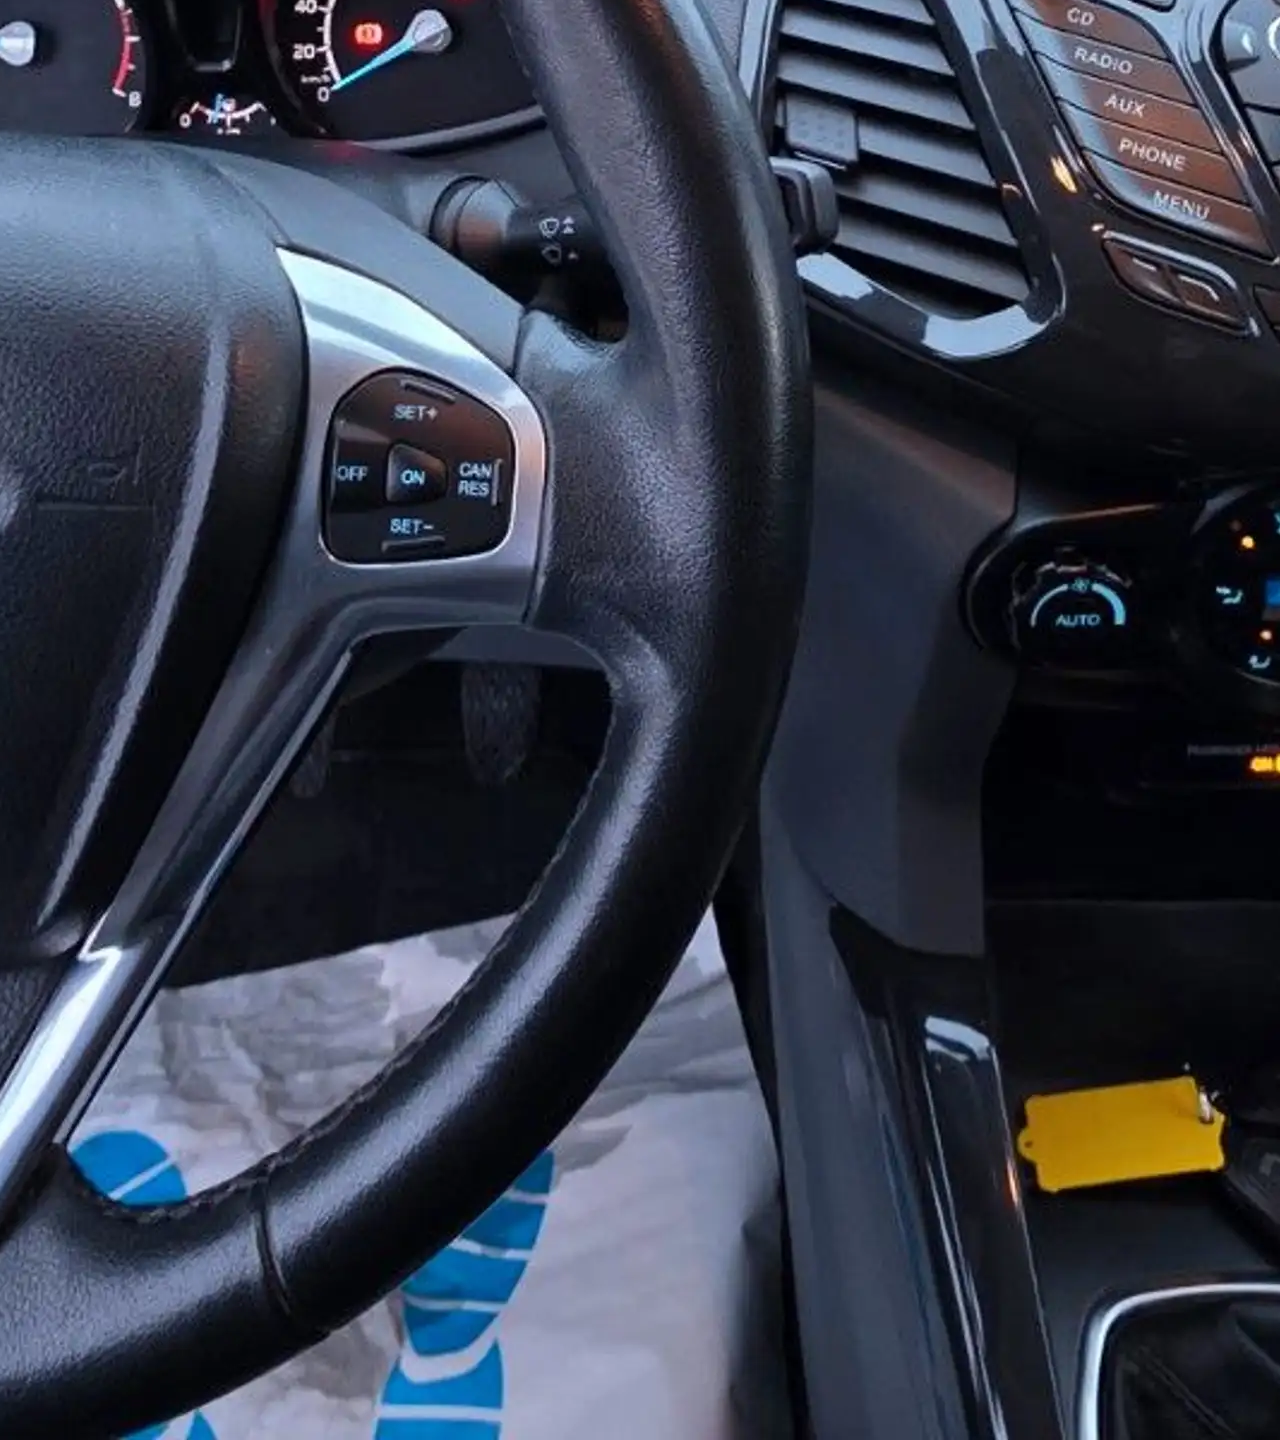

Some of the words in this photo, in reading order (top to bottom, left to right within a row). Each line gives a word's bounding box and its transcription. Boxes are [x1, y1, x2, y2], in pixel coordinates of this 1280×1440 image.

[1066, 7, 1095, 27] CD
[293, 44, 315, 60] 20
[1073, 46, 1133, 75] RADIO
[317, 85, 331, 103] 0
[1104, 92, 1147, 118] AUX
[1118, 137, 1187, 172] PHONE
[1152, 189, 1211, 221] MENU
[393, 404, 439, 422] SET+
[336, 465, 368, 481] OFF
[400, 469, 426, 486] ON
[459, 462, 493, 478] CAN
[458, 480, 489, 497] RES
[389, 517, 435, 535] SET-
[1055, 613, 1101, 627] AUTO
